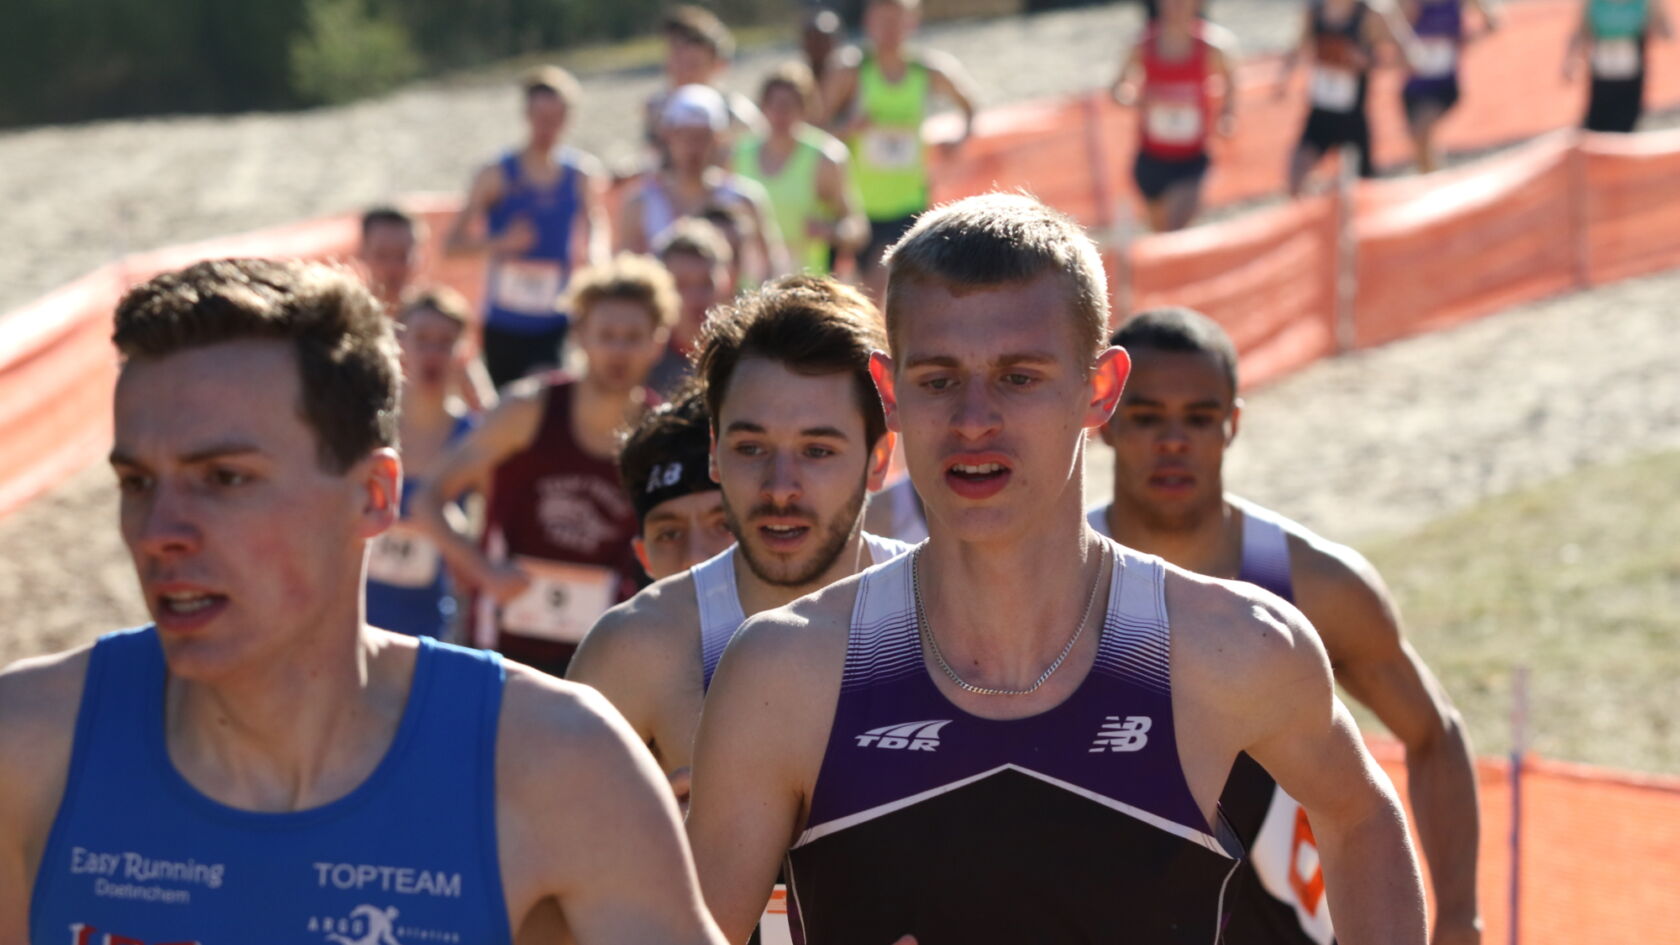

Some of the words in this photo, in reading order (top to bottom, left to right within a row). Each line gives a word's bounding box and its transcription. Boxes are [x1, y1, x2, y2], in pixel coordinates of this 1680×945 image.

[854, 734, 941, 752] TDR
[70, 846, 121, 876] Easy
[122, 852, 225, 888] Running
[313, 862, 462, 898] TOPTEAM
